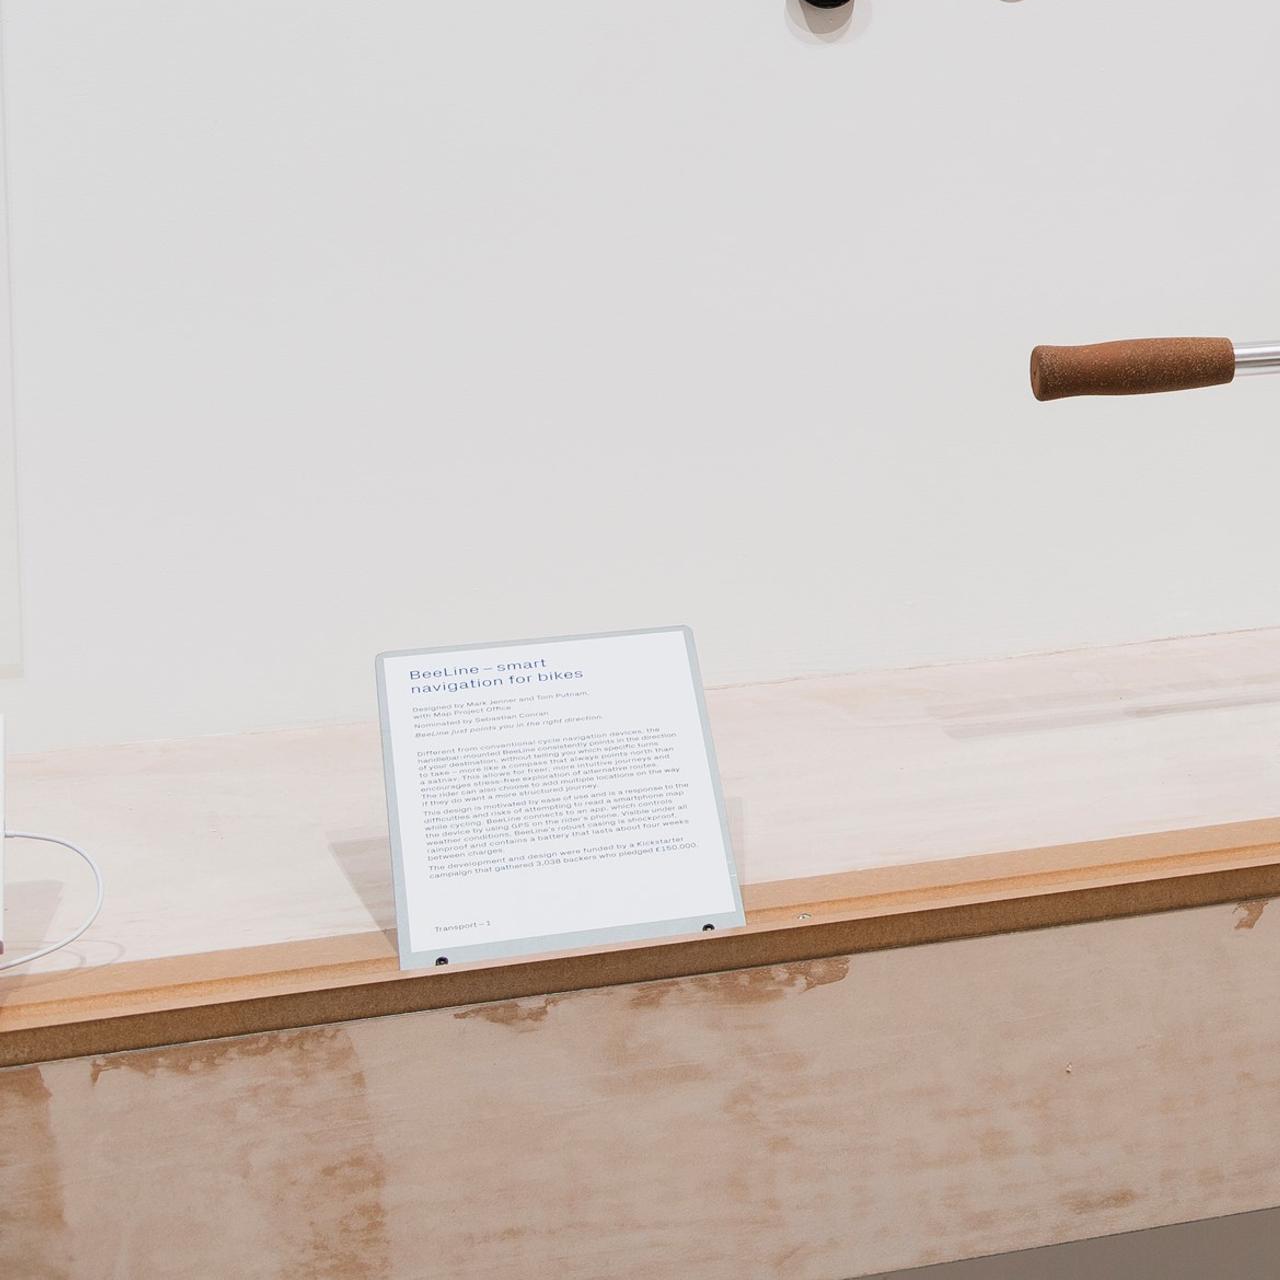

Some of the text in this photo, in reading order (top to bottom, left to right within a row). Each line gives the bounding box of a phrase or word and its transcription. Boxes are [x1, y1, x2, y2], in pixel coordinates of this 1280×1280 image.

[409, 665, 479, 680] BeeLine
[496, 658, 546, 672] smart
[410, 670, 583, 694] navigation for bikes
[434, 921, 477, 932] Transport
